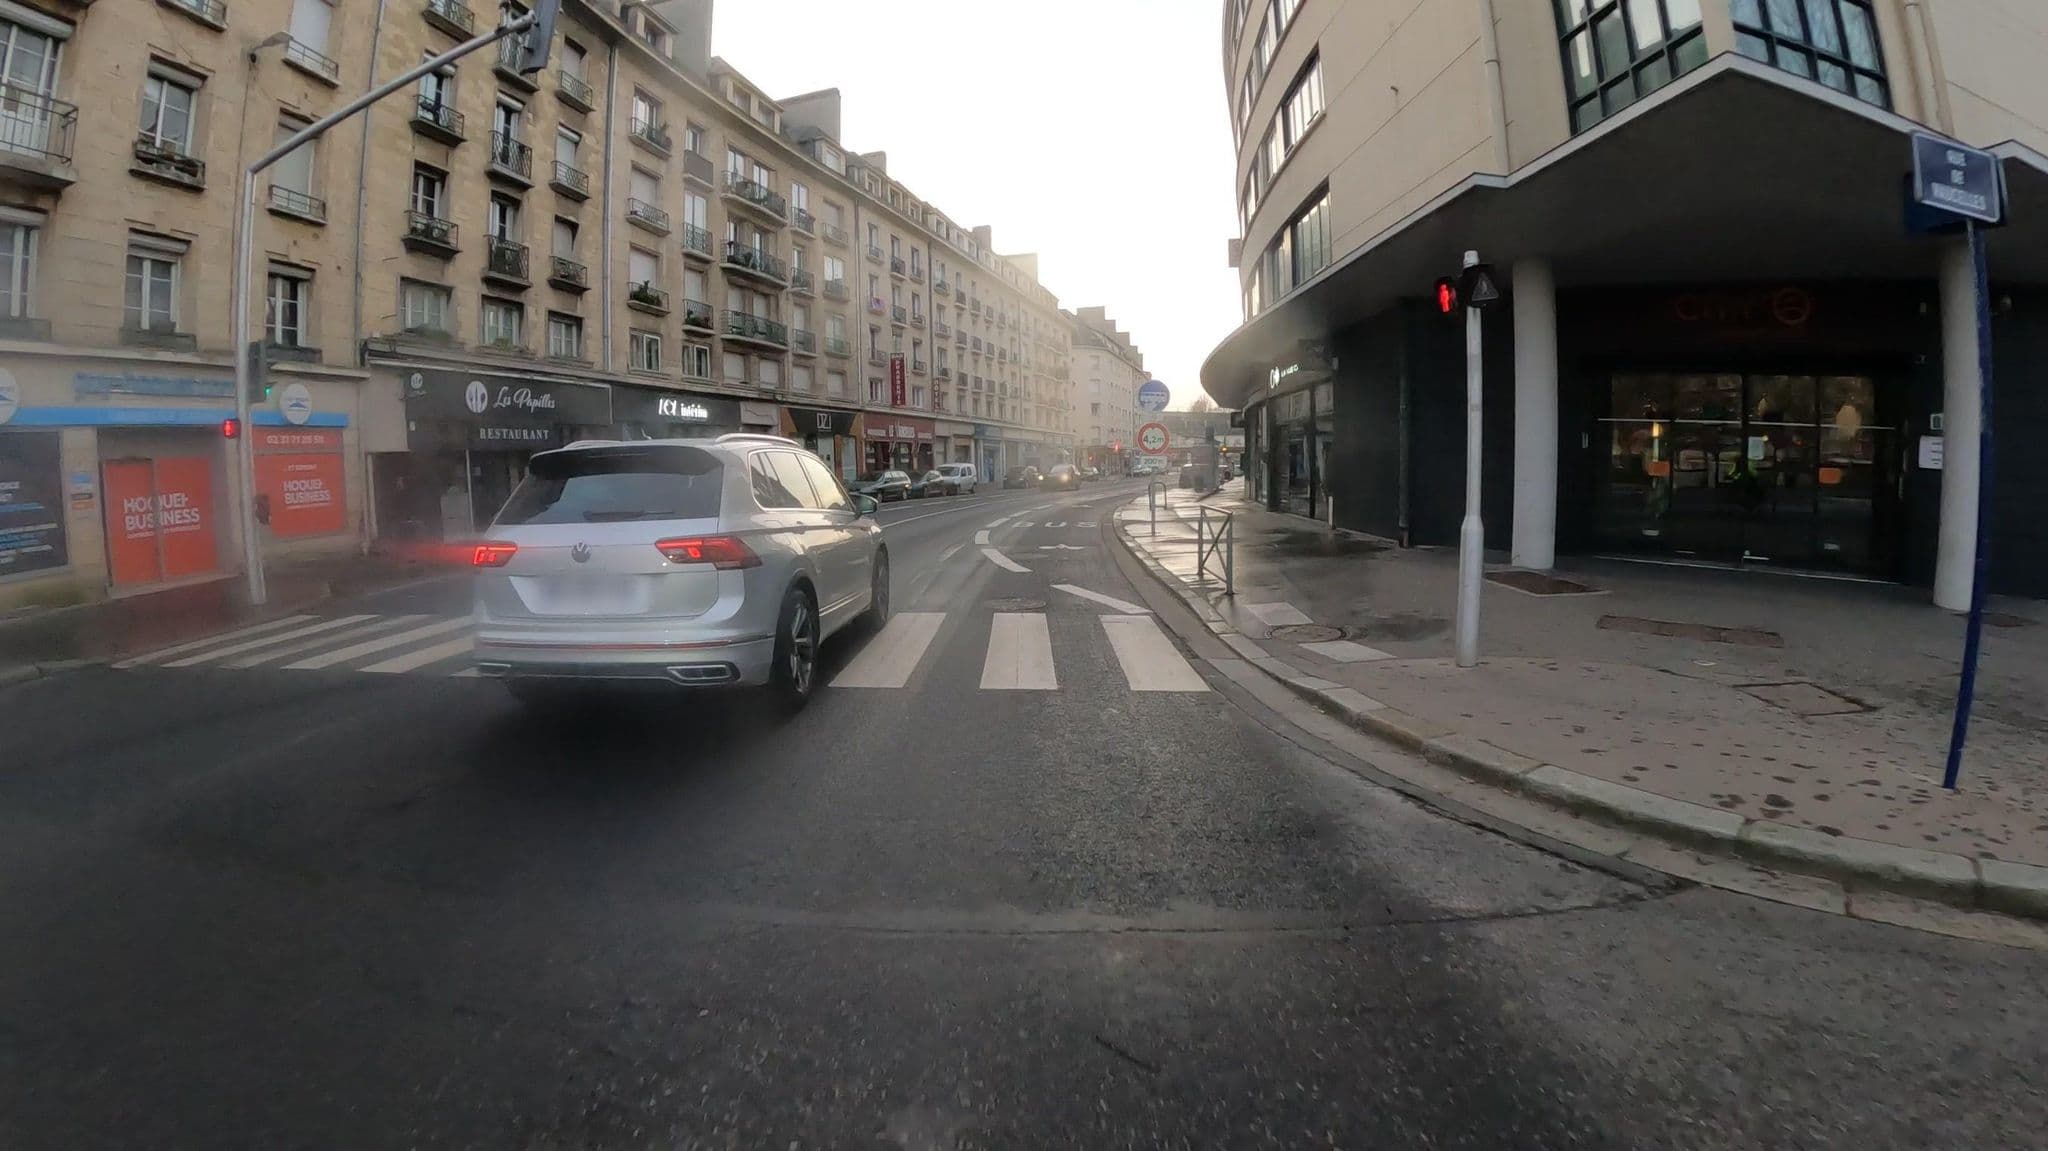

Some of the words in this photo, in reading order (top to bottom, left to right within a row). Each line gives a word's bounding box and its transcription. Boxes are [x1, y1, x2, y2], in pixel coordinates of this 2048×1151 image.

[493, 386, 511, 408] Les
[513, 388, 556, 413] Papilles
[480, 428, 549, 441] RESTAURANT
[284, 489, 331, 504] BUSINESS
[125, 507, 200, 531] BUSINESS
